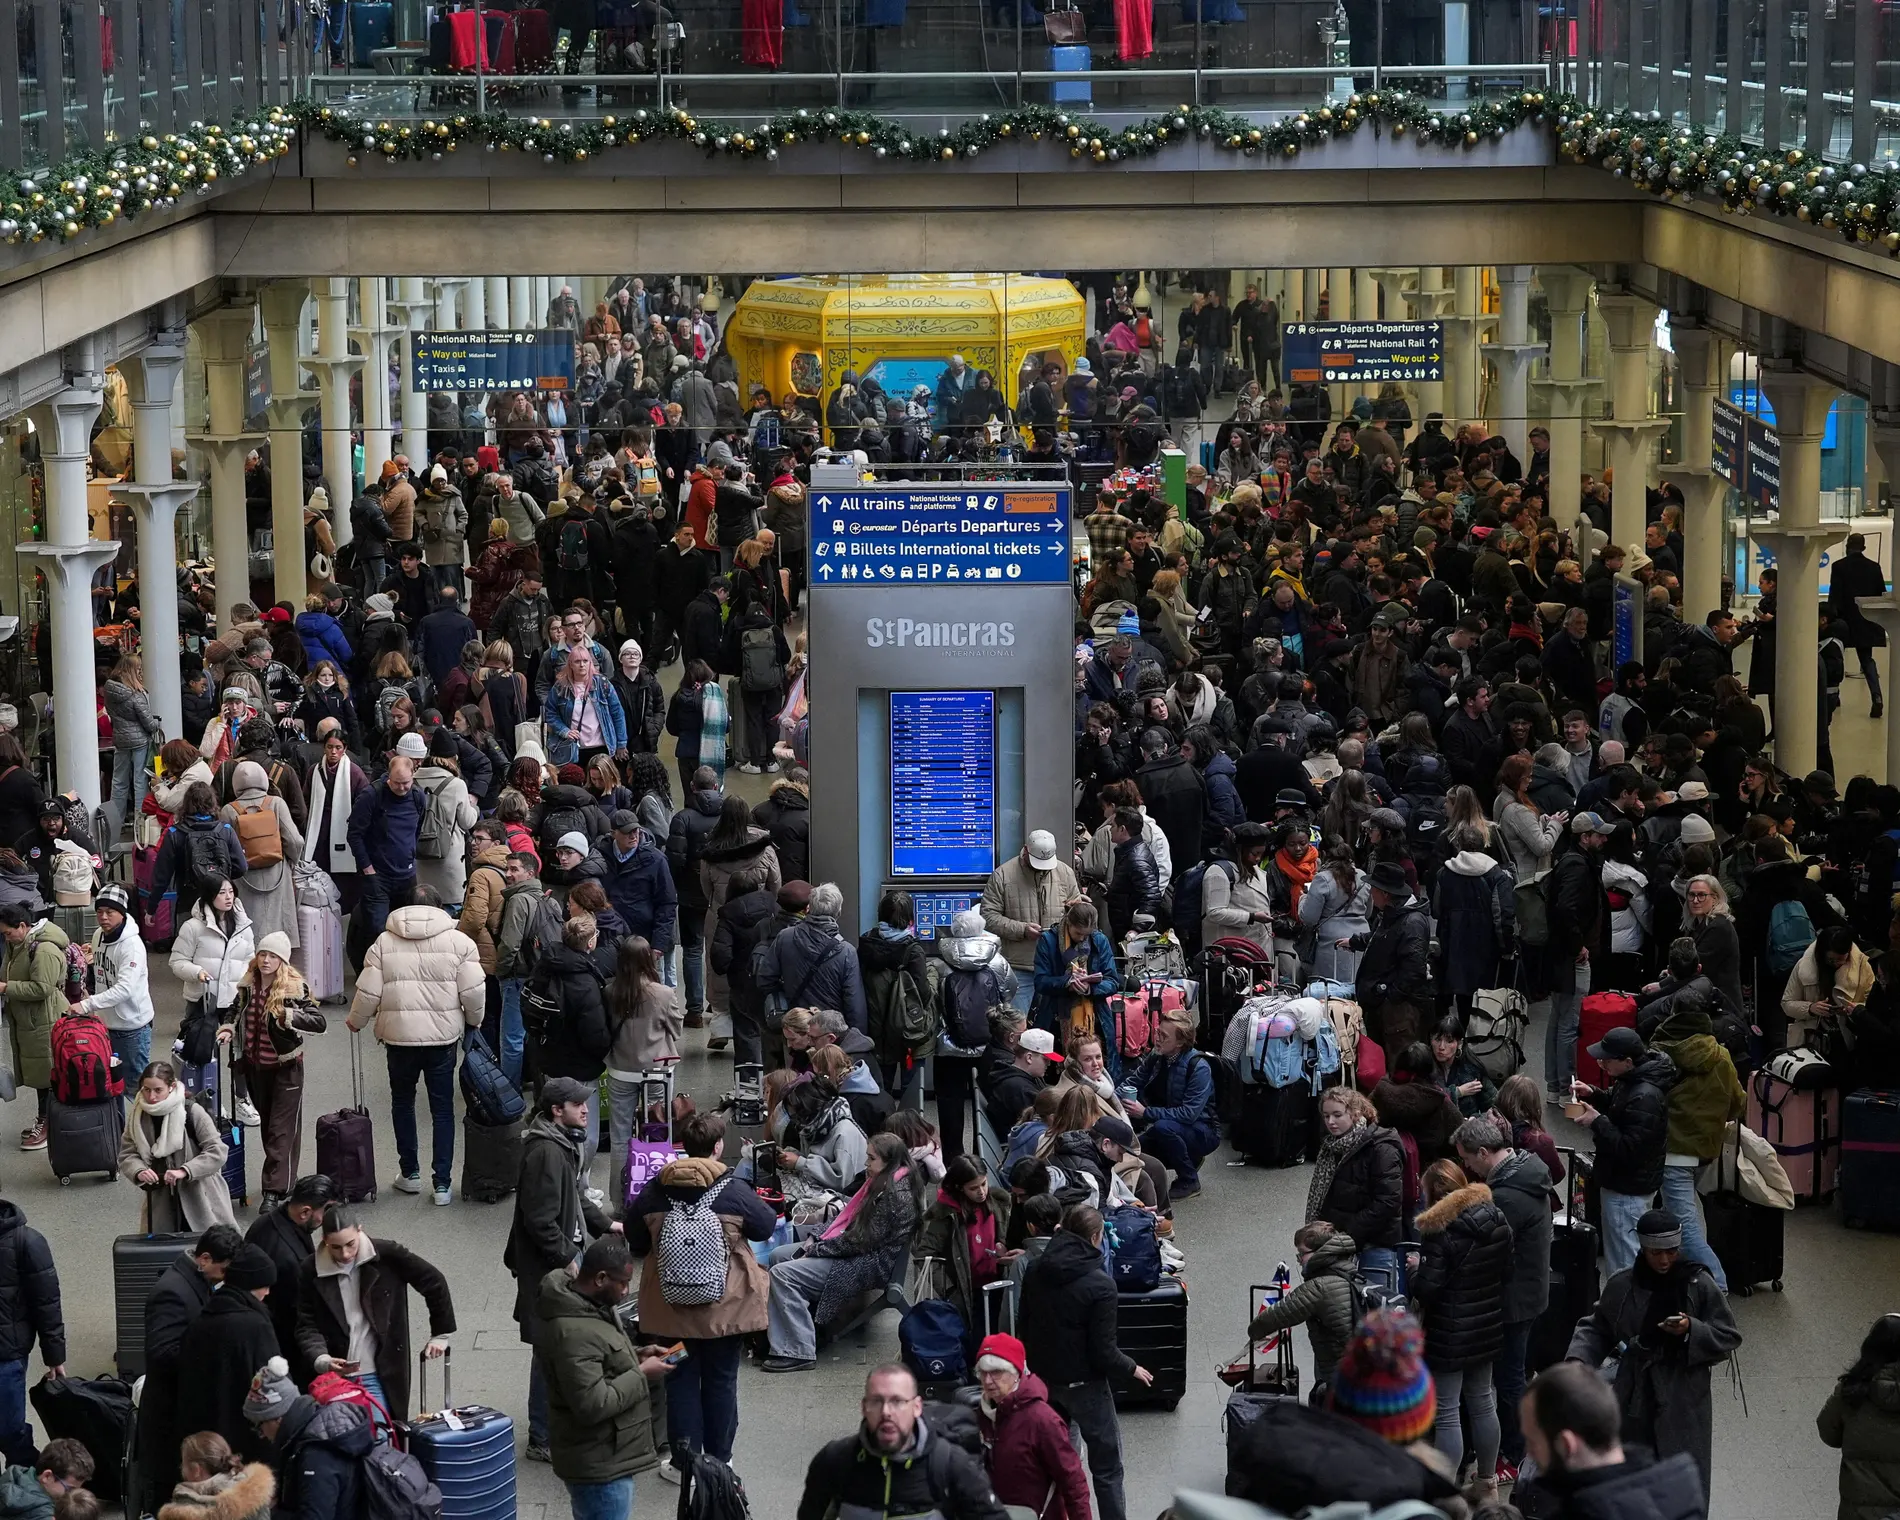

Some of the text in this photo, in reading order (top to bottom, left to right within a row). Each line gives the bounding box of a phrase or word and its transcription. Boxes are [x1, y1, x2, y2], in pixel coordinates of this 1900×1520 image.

[1340, 324, 1425, 334] Départs Departures
[431, 335, 487, 343] National Rail
[1370, 339, 1425, 348] National Rail
[432, 350, 450, 359] Way
[1391, 355, 1410, 364] Way
[840, 497, 905, 510] All trains
[924, 503, 956, 511] platforms
[862, 524, 897, 532] eurostar
[902, 519, 1040, 535] Départs Departures
[851, 543, 1041, 555] Billets International tickets
